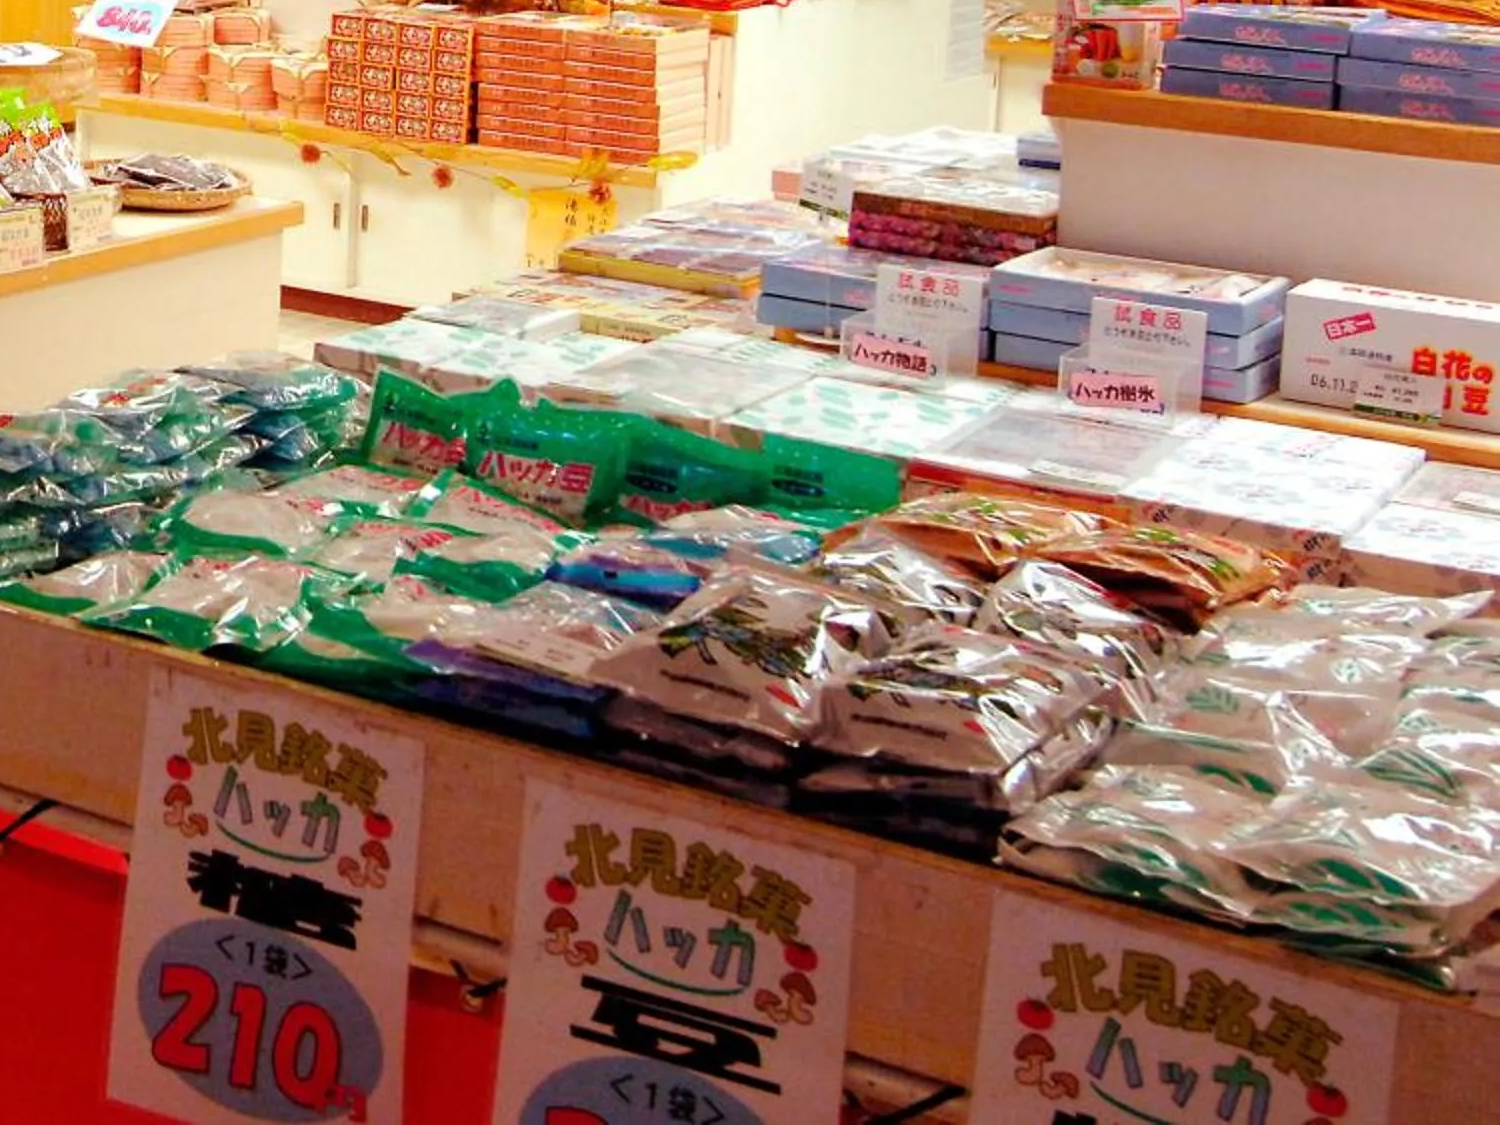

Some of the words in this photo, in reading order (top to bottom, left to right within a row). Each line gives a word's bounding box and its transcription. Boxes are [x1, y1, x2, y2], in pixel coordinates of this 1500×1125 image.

[898, 272, 960, 298] 試食品
[1113, 304, 1185, 331] 試食品
[1411, 346, 1495, 386] 白花の
[212, 764, 342, 855] ハッカ
[603, 888, 757, 989] ハッカ
[568, 973, 783, 1096] 豆
[1085, 1015, 1272, 1125] ハッカ
